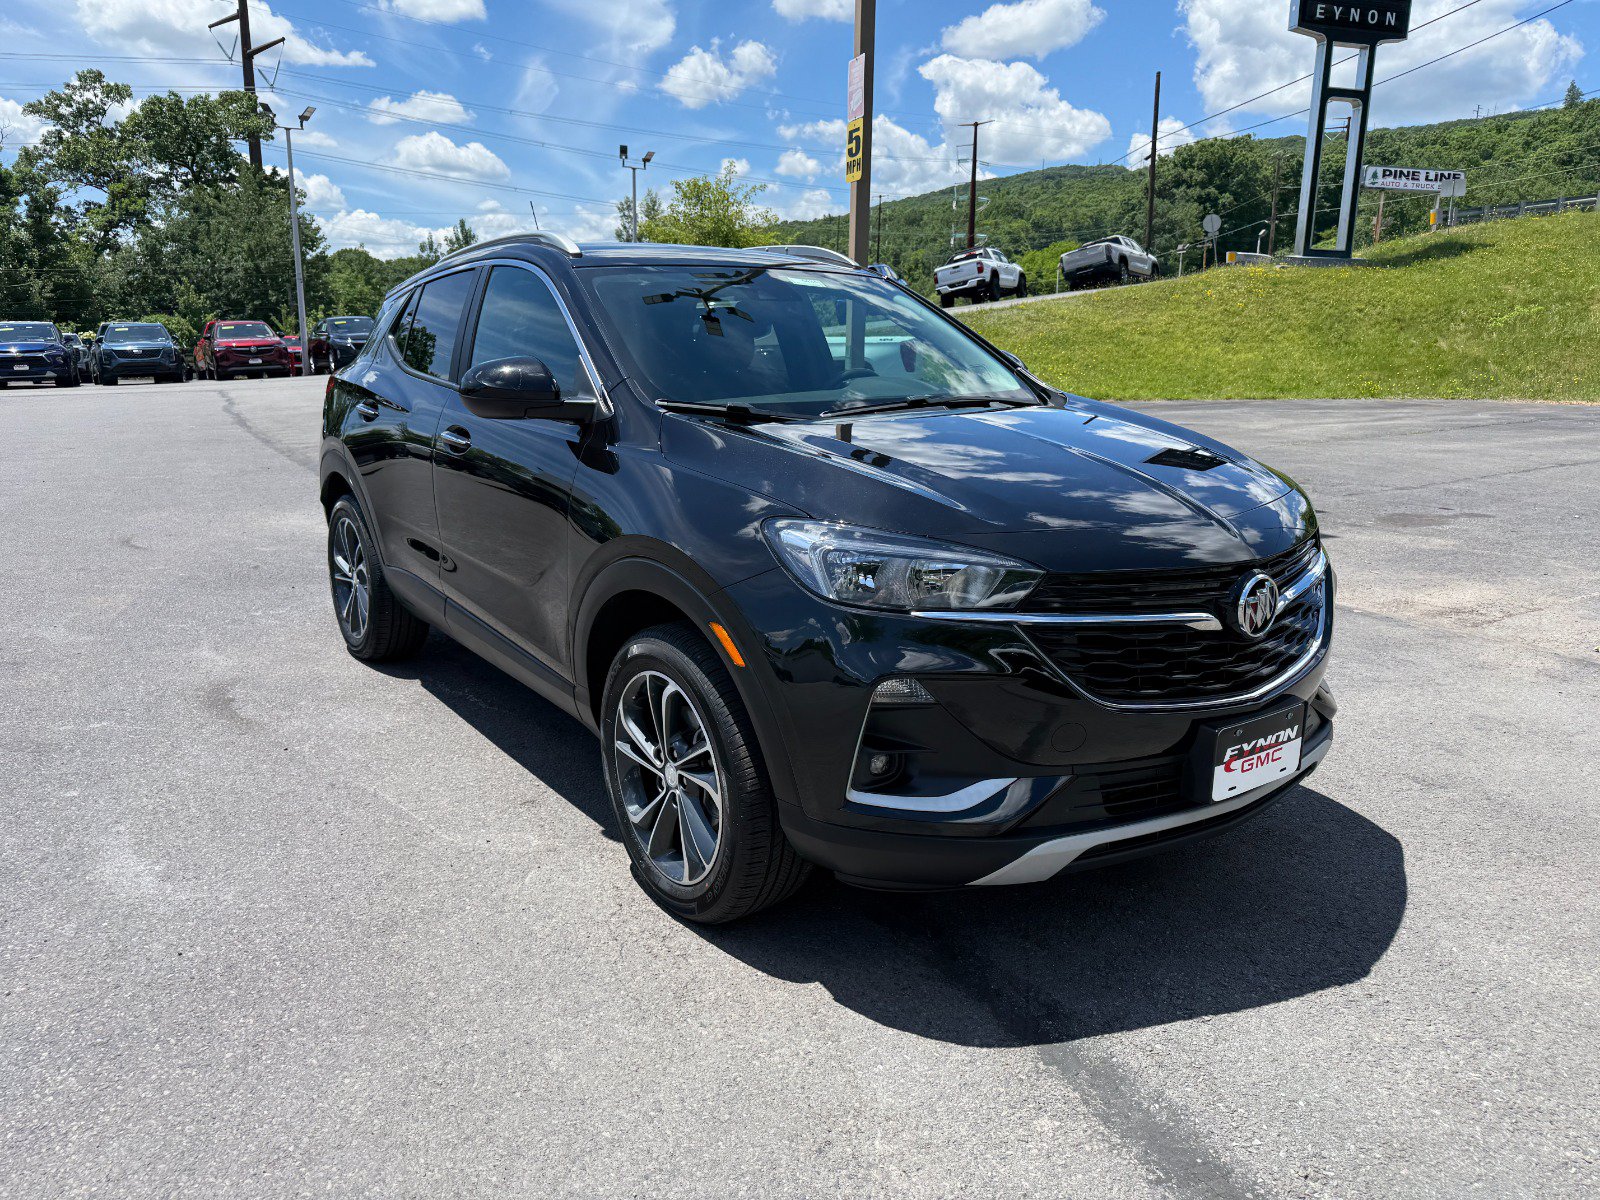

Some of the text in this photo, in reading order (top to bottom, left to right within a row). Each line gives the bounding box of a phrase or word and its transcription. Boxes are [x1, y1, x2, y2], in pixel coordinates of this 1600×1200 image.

[1316, 4, 1396, 26] EYNON
[848, 127, 861, 158] 5
[846, 158, 861, 175] MPH
[1381, 168, 1421, 182] PINE
[1241, 747, 1282, 773] GMC
